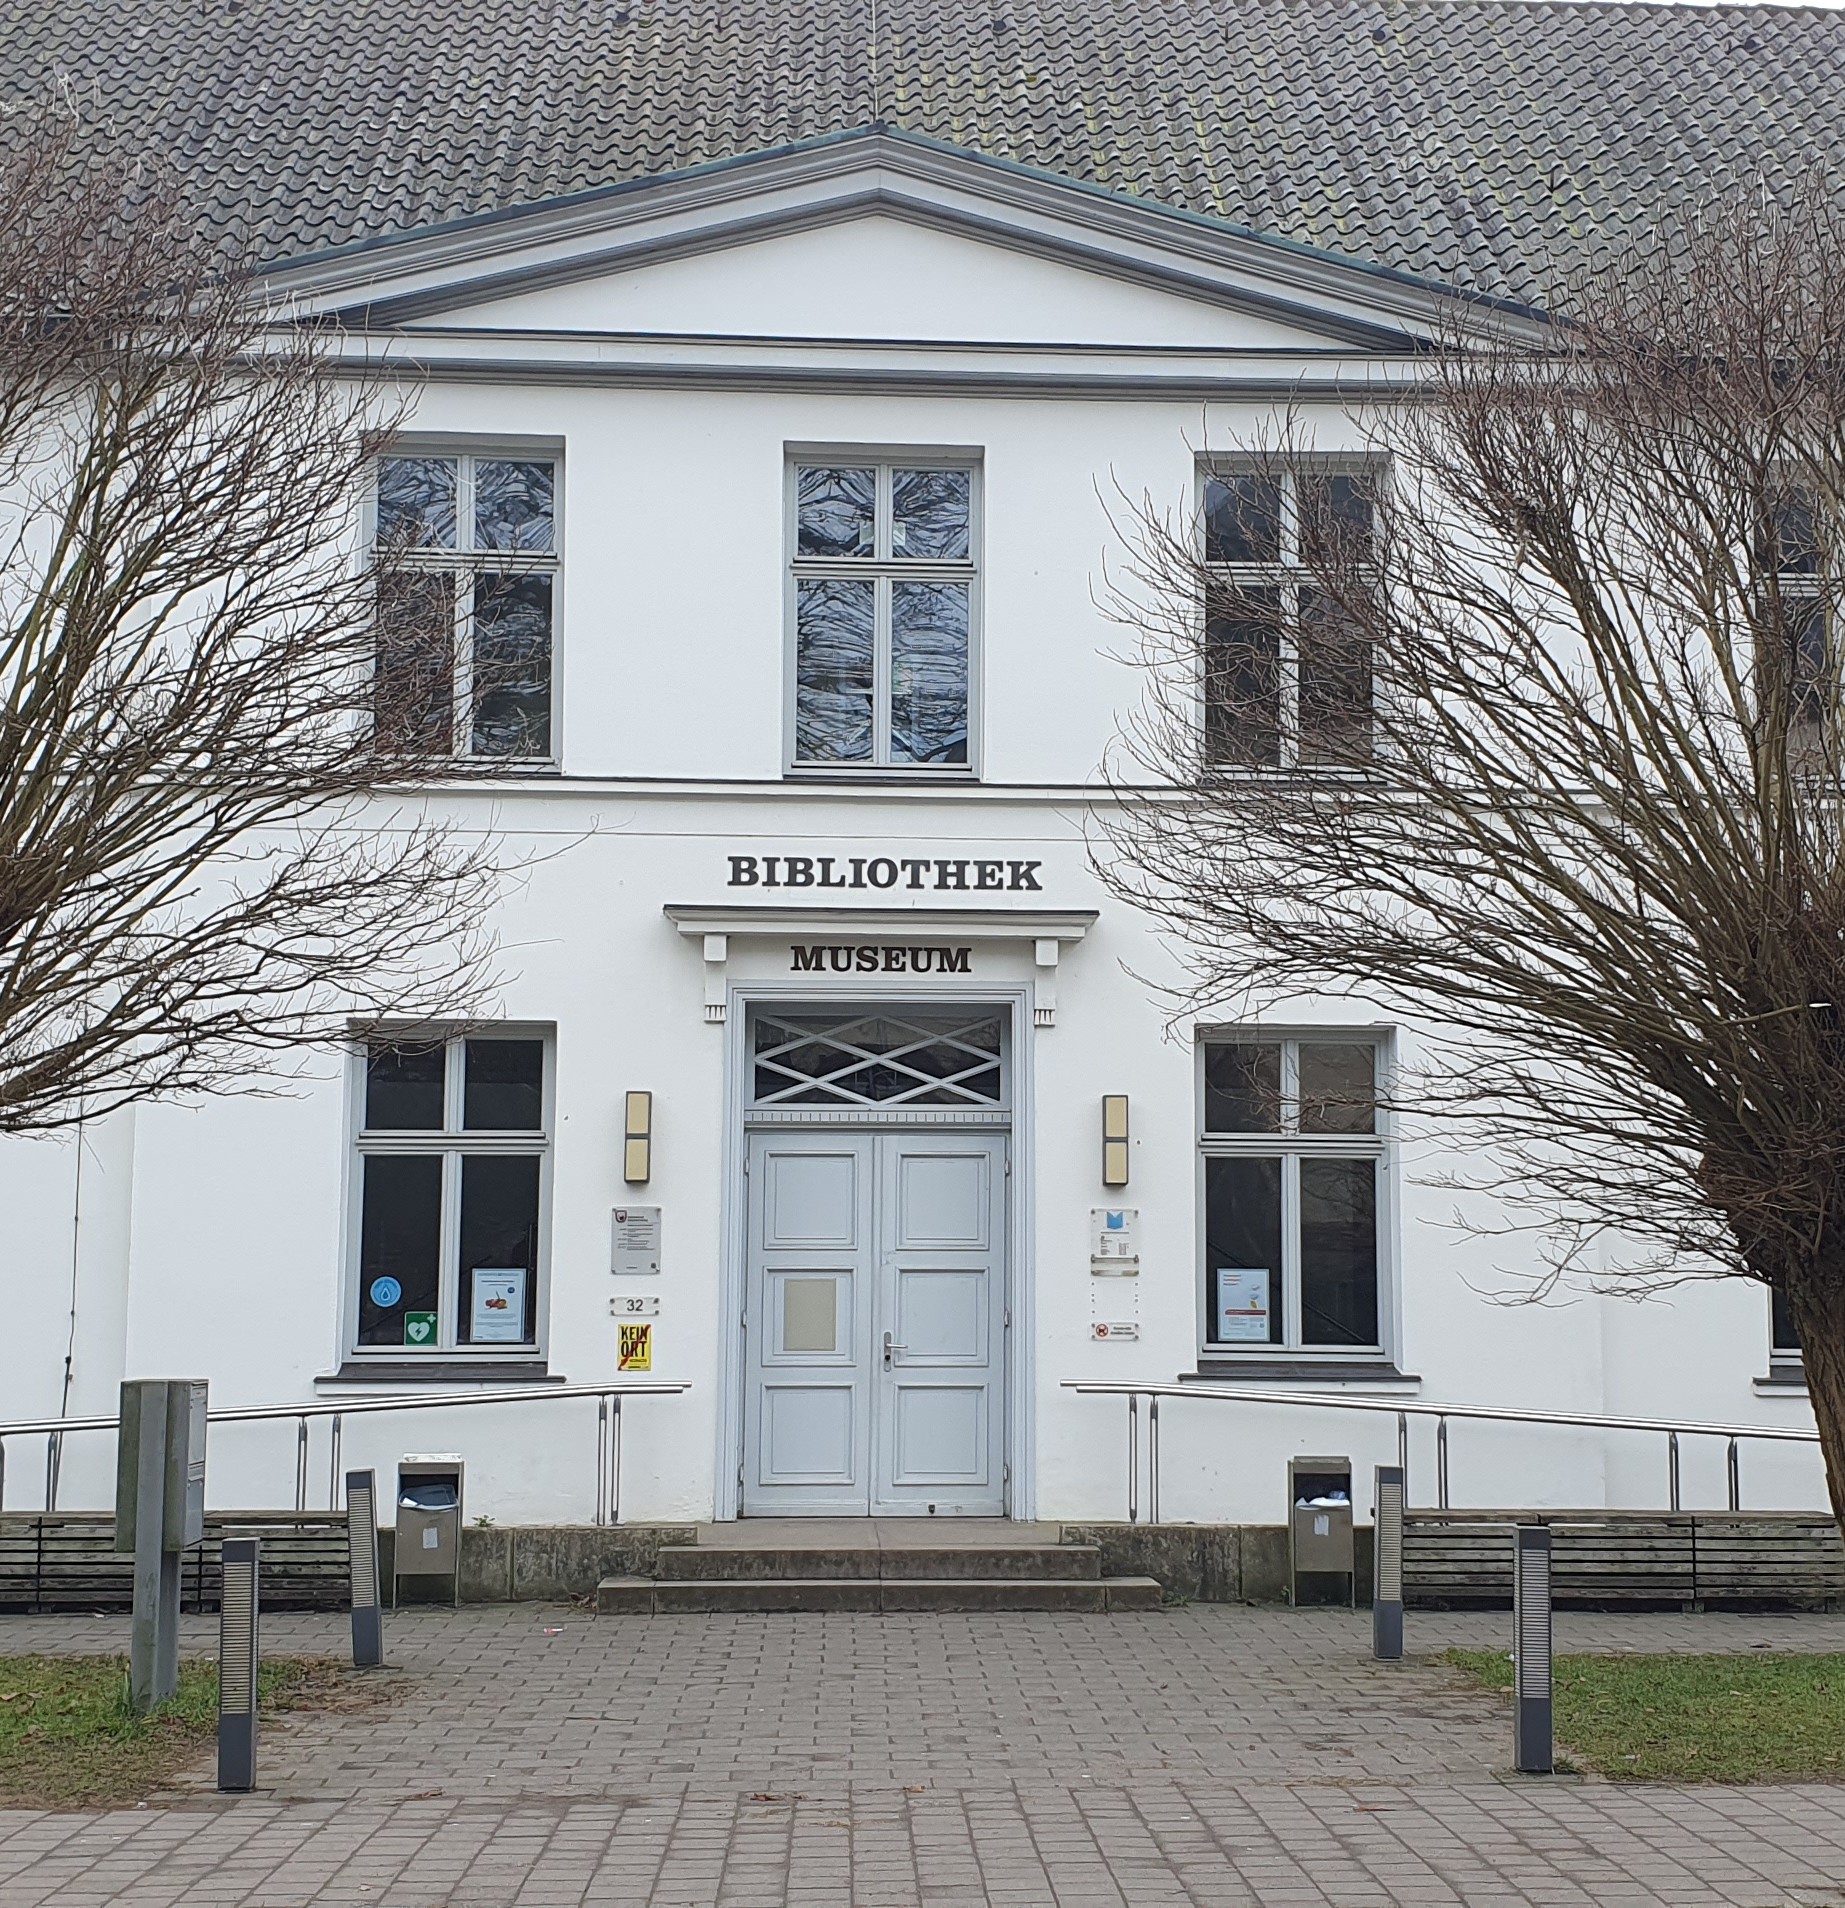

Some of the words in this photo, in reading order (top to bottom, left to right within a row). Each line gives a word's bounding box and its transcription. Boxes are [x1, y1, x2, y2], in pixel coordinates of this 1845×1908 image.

[727, 856, 1043, 890] BIBLIOTHEK
[790, 945, 973, 973] MUSEUM
[626, 1299, 644, 1312] 32
[620, 1325, 648, 1341] KEIN
[620, 1340, 648, 1357] ORT
